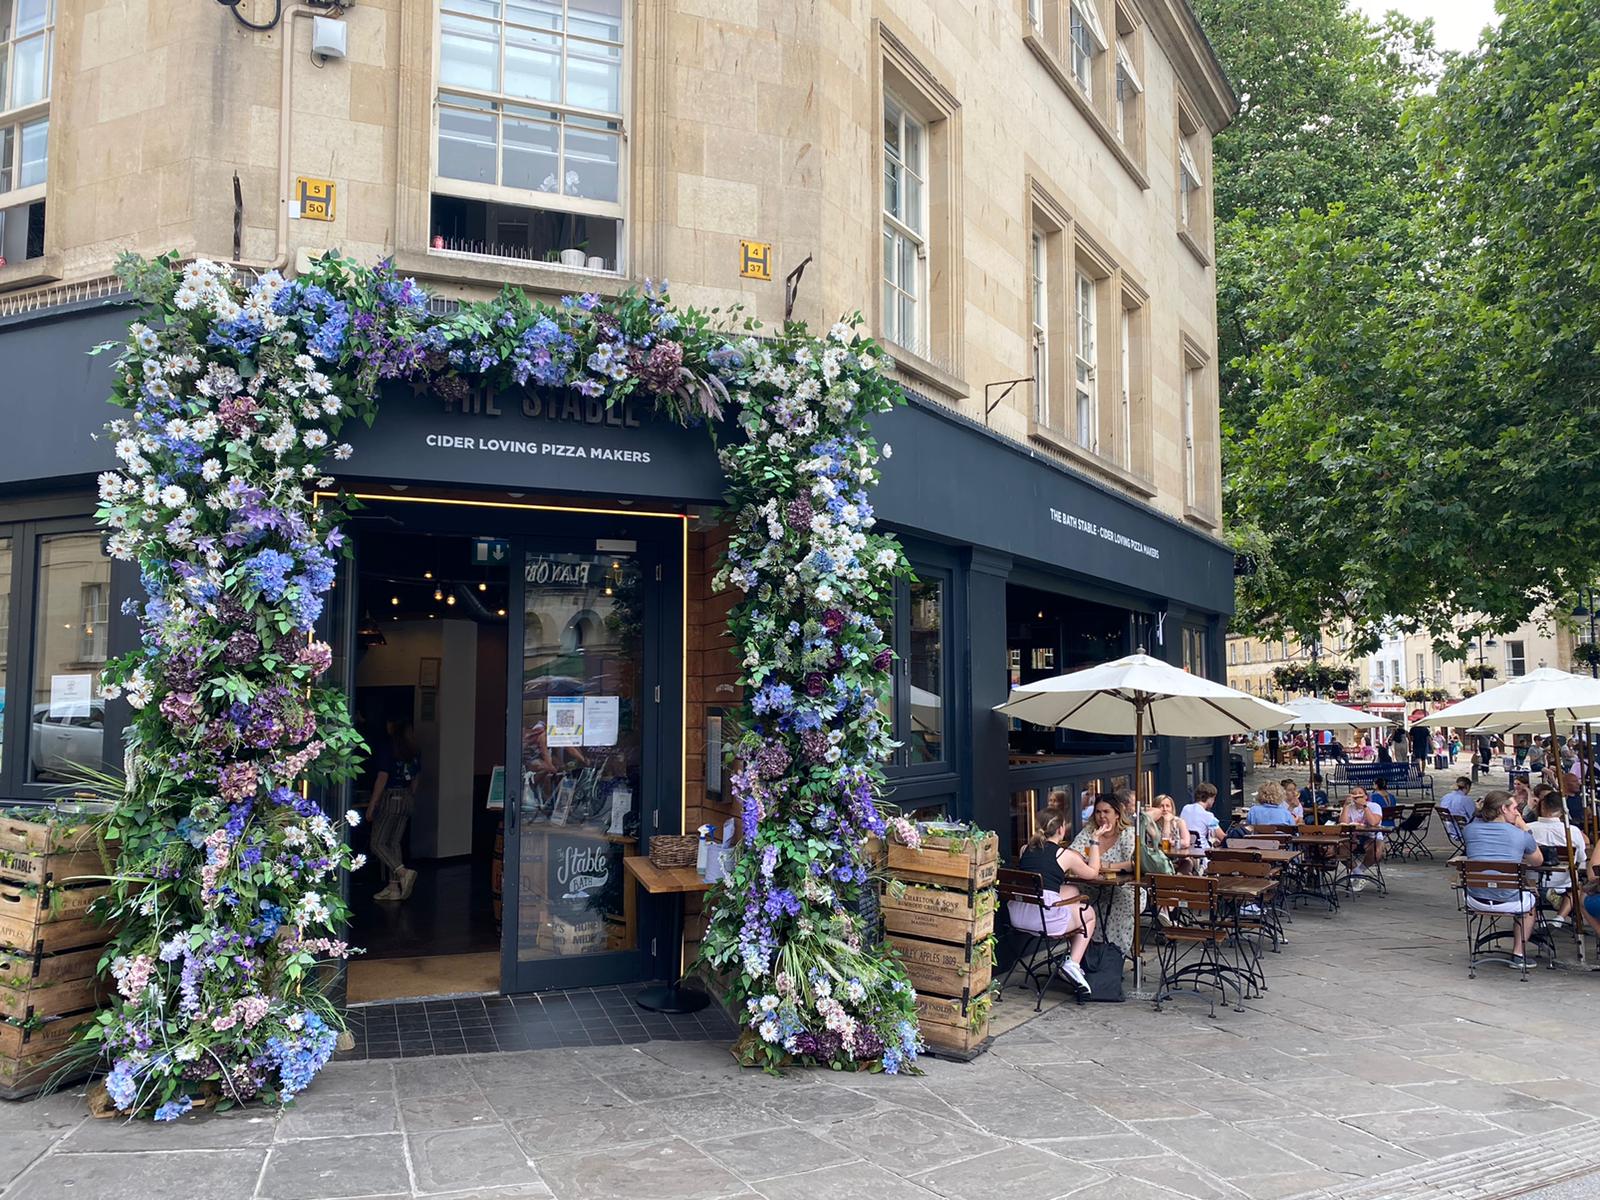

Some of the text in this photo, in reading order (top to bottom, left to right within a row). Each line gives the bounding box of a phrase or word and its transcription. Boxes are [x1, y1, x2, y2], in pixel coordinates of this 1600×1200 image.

[313, 185, 321, 194] 5
[309, 203, 324, 213] 50
[752, 248, 759, 256] 4
[750, 264, 761, 273] 37
[441, 383, 502, 416] HE
[426, 434, 651, 464] CIDER LOVING PIZZA MAKERS
[1050, 507, 1160, 560] THE BATH STABLE CIDER LOVING PIZZA MAKERS
[557, 846, 608, 884] Stable
[918, 951, 940, 963] APPLES
